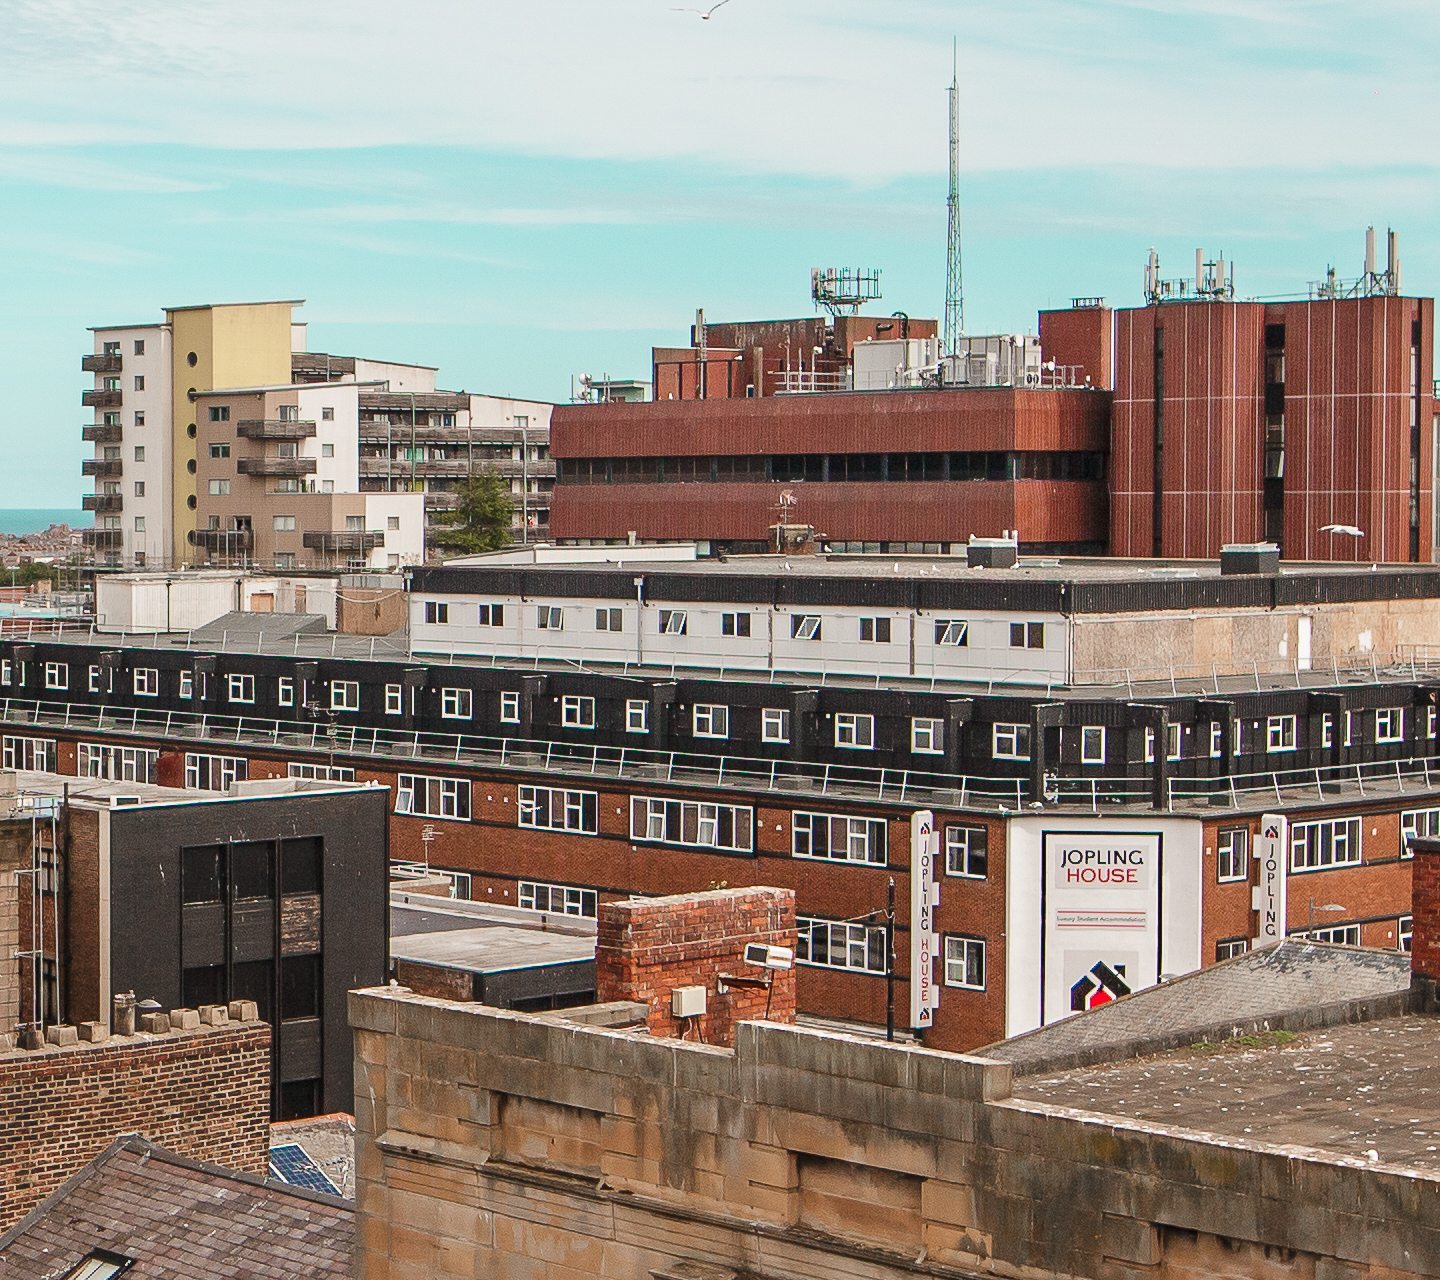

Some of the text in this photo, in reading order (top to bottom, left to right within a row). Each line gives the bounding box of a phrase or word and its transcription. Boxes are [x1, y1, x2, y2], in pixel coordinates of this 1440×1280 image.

[1060, 849, 1144, 868] JOPLING
[1066, 868, 1138, 883] HOUSE
[1265, 843, 1276, 936] JOPLING
[921, 840, 929, 1002] JOPLING HOUSE
